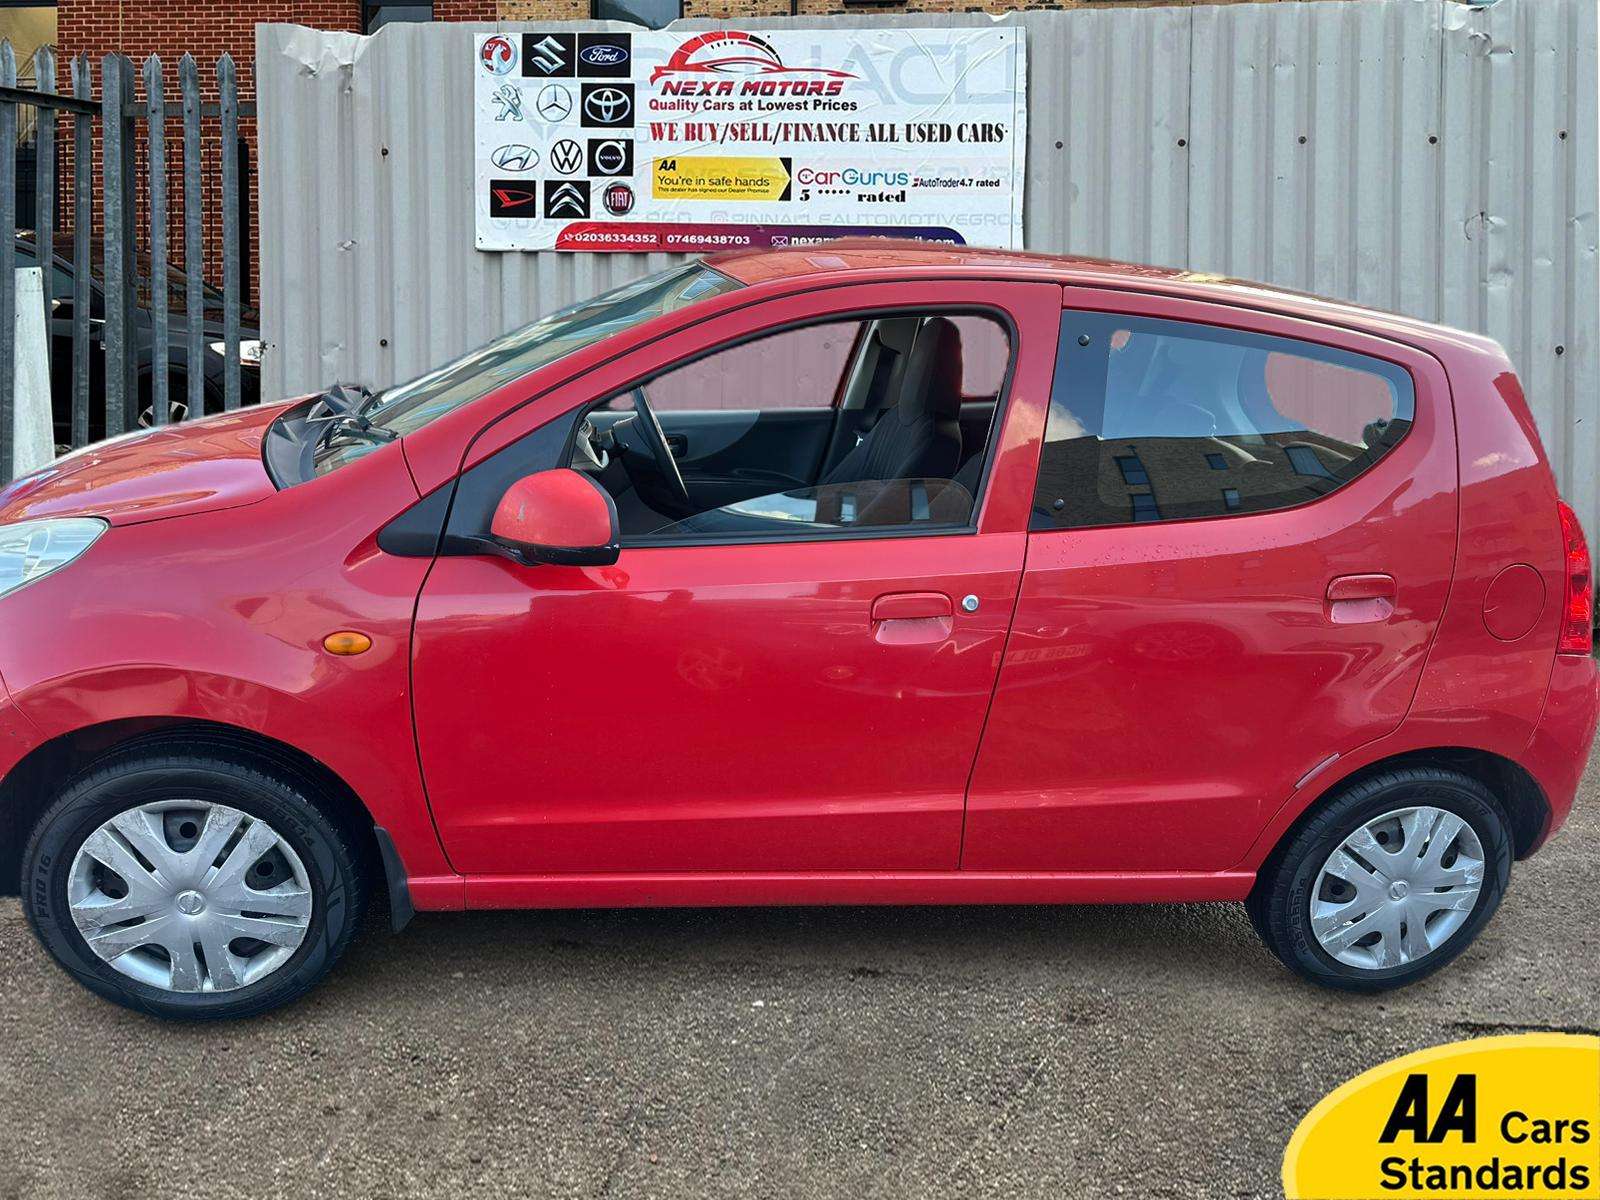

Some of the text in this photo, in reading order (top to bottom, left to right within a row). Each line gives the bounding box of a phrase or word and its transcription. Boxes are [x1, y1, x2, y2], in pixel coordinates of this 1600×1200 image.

[588, 49, 618, 63] Ford
[661, 80, 844, 96] NEXA MOTORS
[649, 99, 858, 113] Quality Cars at Lowest Prices
[650, 122, 678, 142] WE
[865, 123, 900, 142] ALL
[905, 123, 952, 143] USED
[956, 122, 1005, 143] CARS
[658, 159, 677, 171] AA
[658, 175, 770, 187] You're in safe hands
[797, 168, 909, 186] CarGurus
[976, 177, 1001, 188] rated
[610, 191, 629, 207] FIAT
[800, 189, 907, 203] 5 rated
[576, 233, 657, 243] 02036334352
[666, 235, 751, 245] 07469438703
